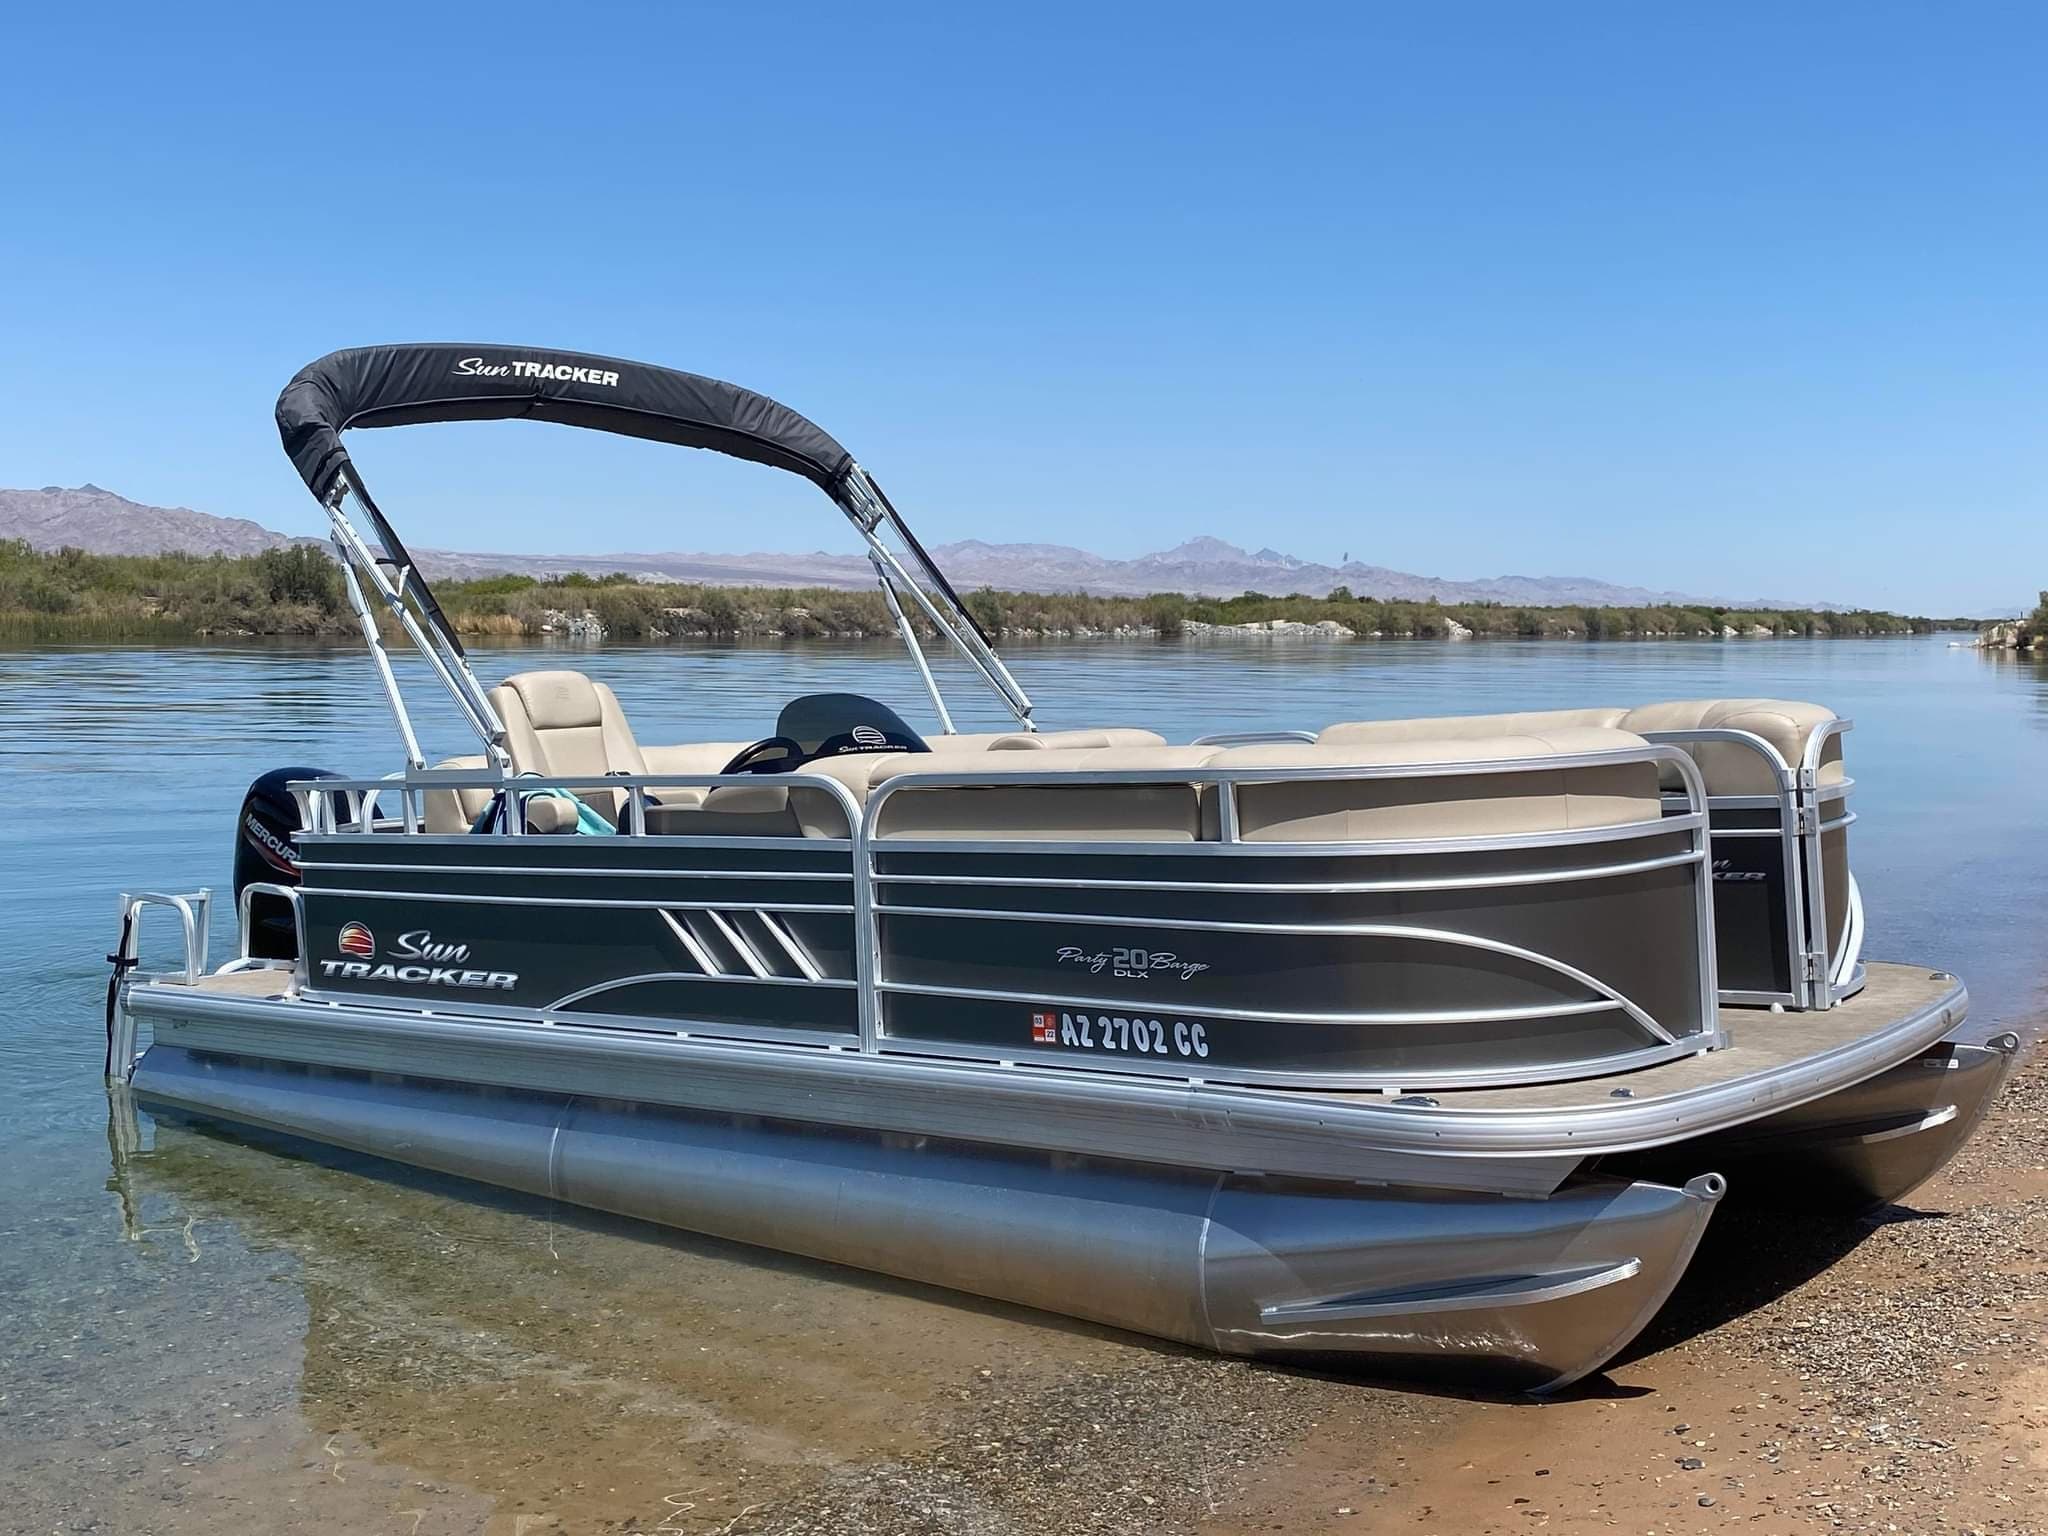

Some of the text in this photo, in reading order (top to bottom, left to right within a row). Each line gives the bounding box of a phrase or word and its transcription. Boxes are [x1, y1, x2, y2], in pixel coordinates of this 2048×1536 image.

[452, 358, 620, 387] Sun TRACKER
[386, 930, 471, 962] Sun
[320, 959, 519, 991] TRACKER
[1056, 947, 1211, 981] Party 20 Barge
[1113, 969, 1149, 979] DLX
[1061, 1013, 1209, 1058] AZ 2702 CC
